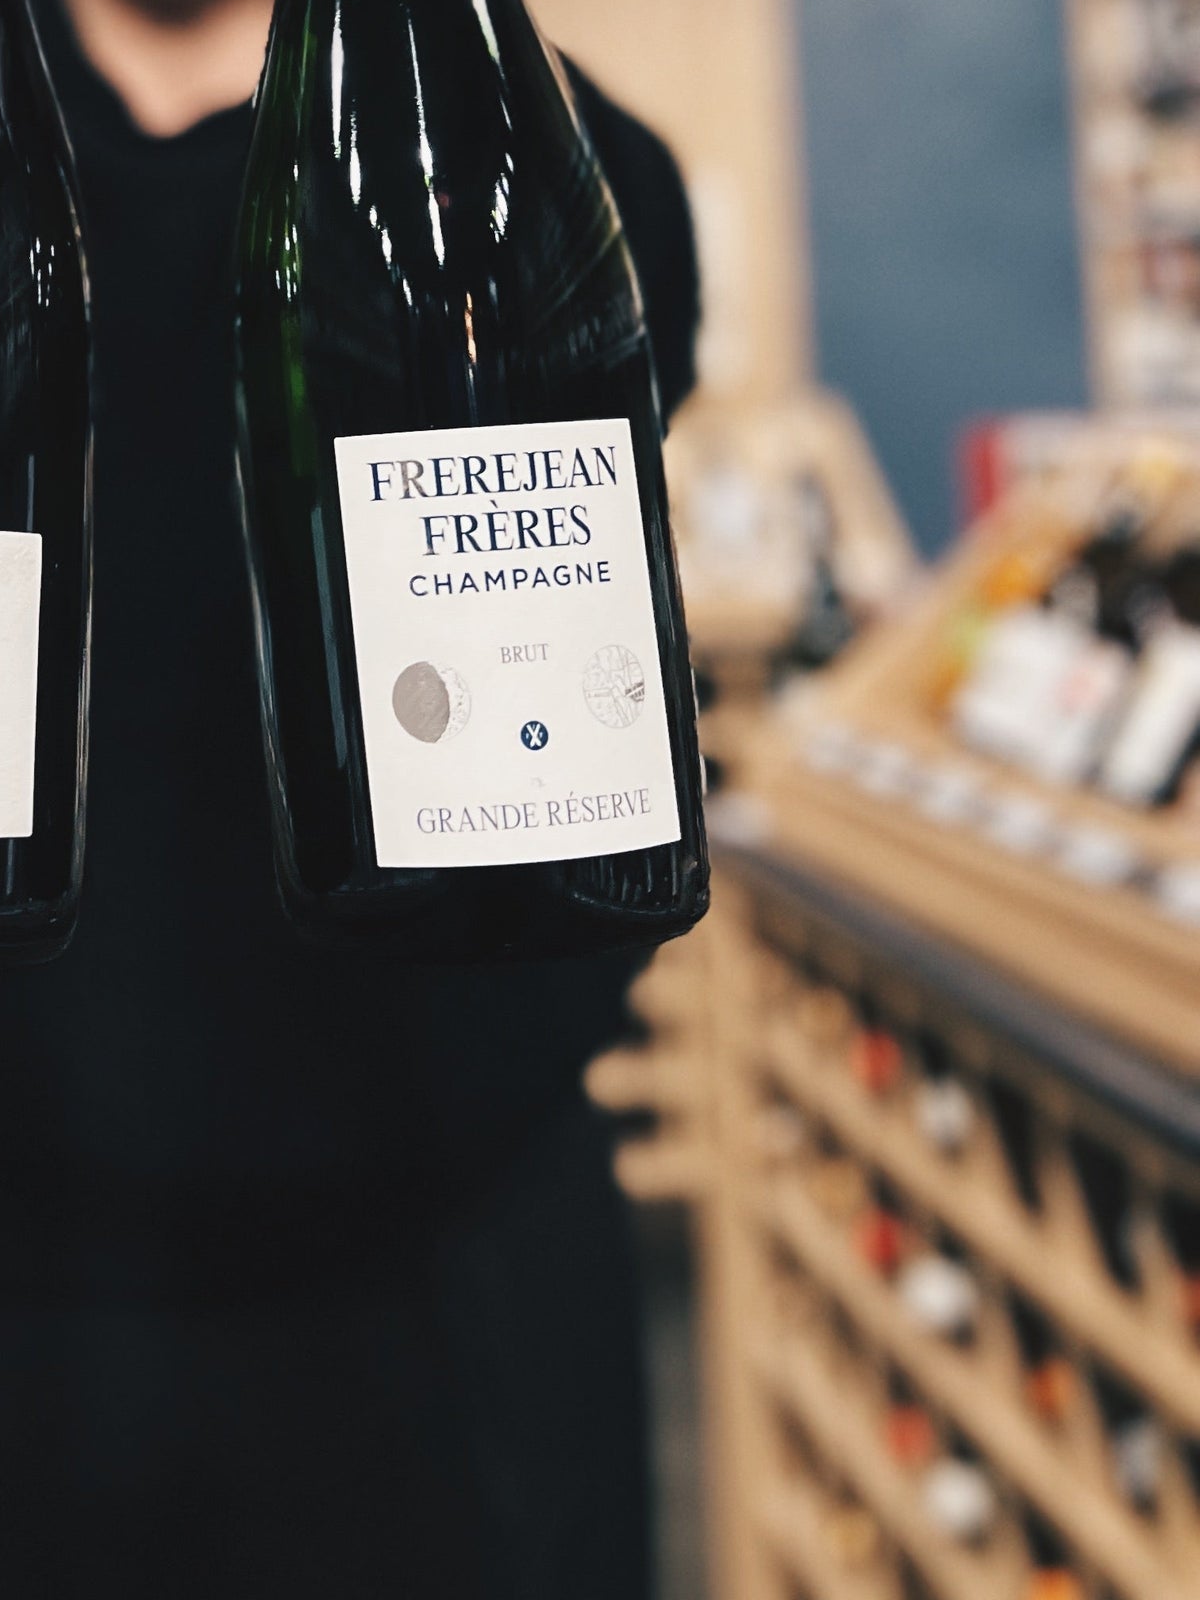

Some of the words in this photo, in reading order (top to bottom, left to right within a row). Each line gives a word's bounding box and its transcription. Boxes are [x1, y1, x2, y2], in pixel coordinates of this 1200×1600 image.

[366, 446, 617, 501] FREREJEAN
[420, 500, 591, 556] FRÈRES
[409, 560, 611, 597] CHAMPAGNE
[499, 643, 549, 664] BRUT
[416, 802, 539, 834] GRANDE
[546, 788, 652, 827] RÉSERVE
